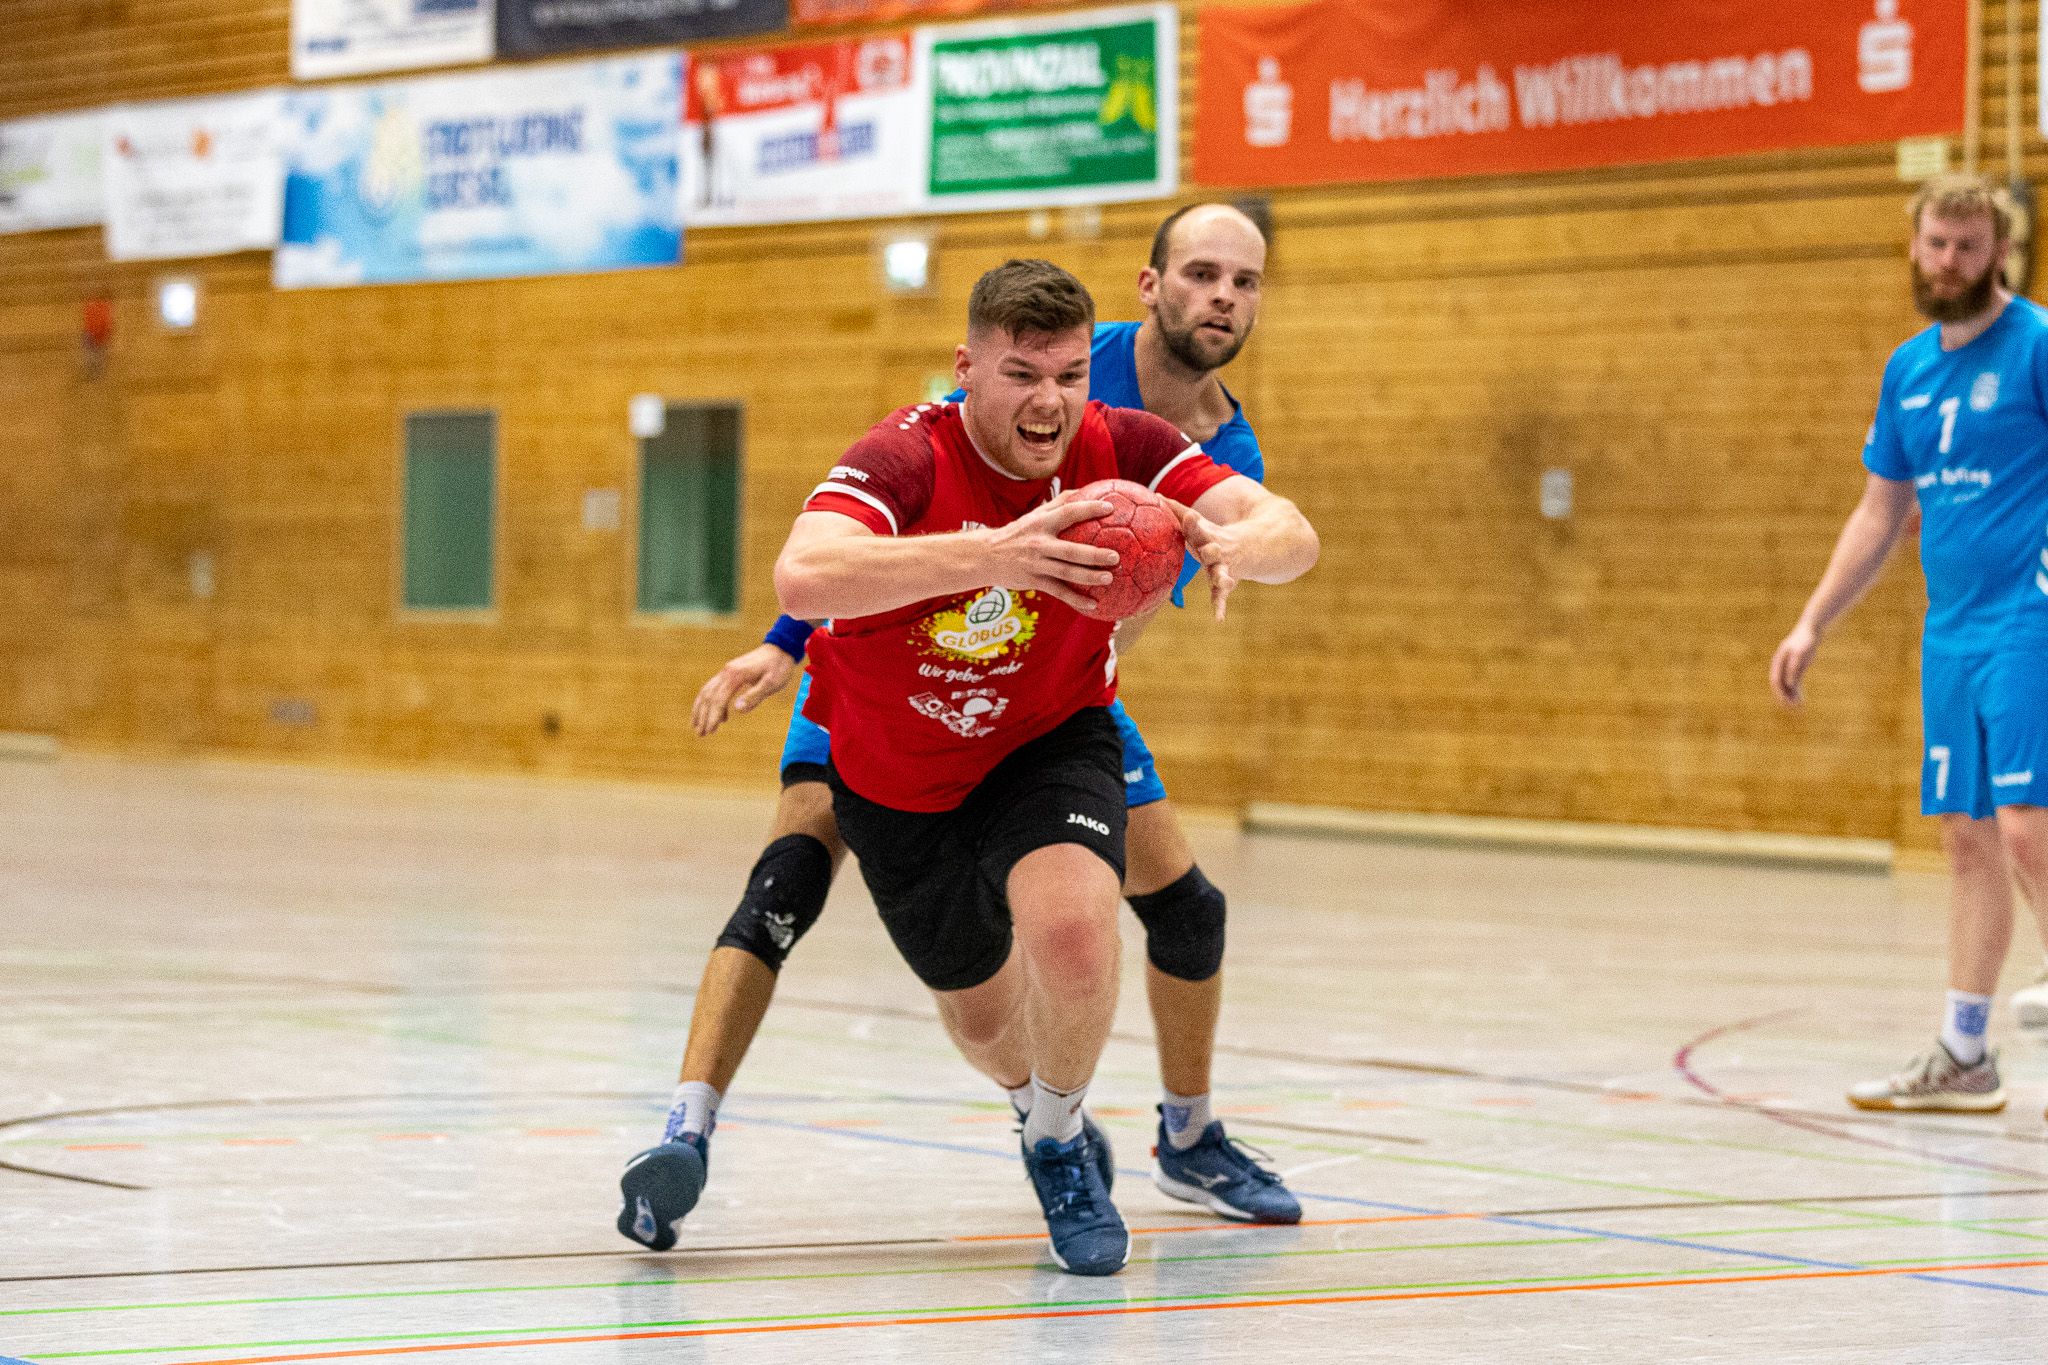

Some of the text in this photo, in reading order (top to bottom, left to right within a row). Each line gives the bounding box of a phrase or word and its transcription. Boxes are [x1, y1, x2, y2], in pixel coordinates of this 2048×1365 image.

[1329, 48, 1814, 142] Herzlich Willkommen
[942, 620, 1015, 649] GLOBUS
[918, 662, 946, 678] Wir
[1929, 745, 1950, 800] 7
[1066, 812, 1110, 836] JAKO
